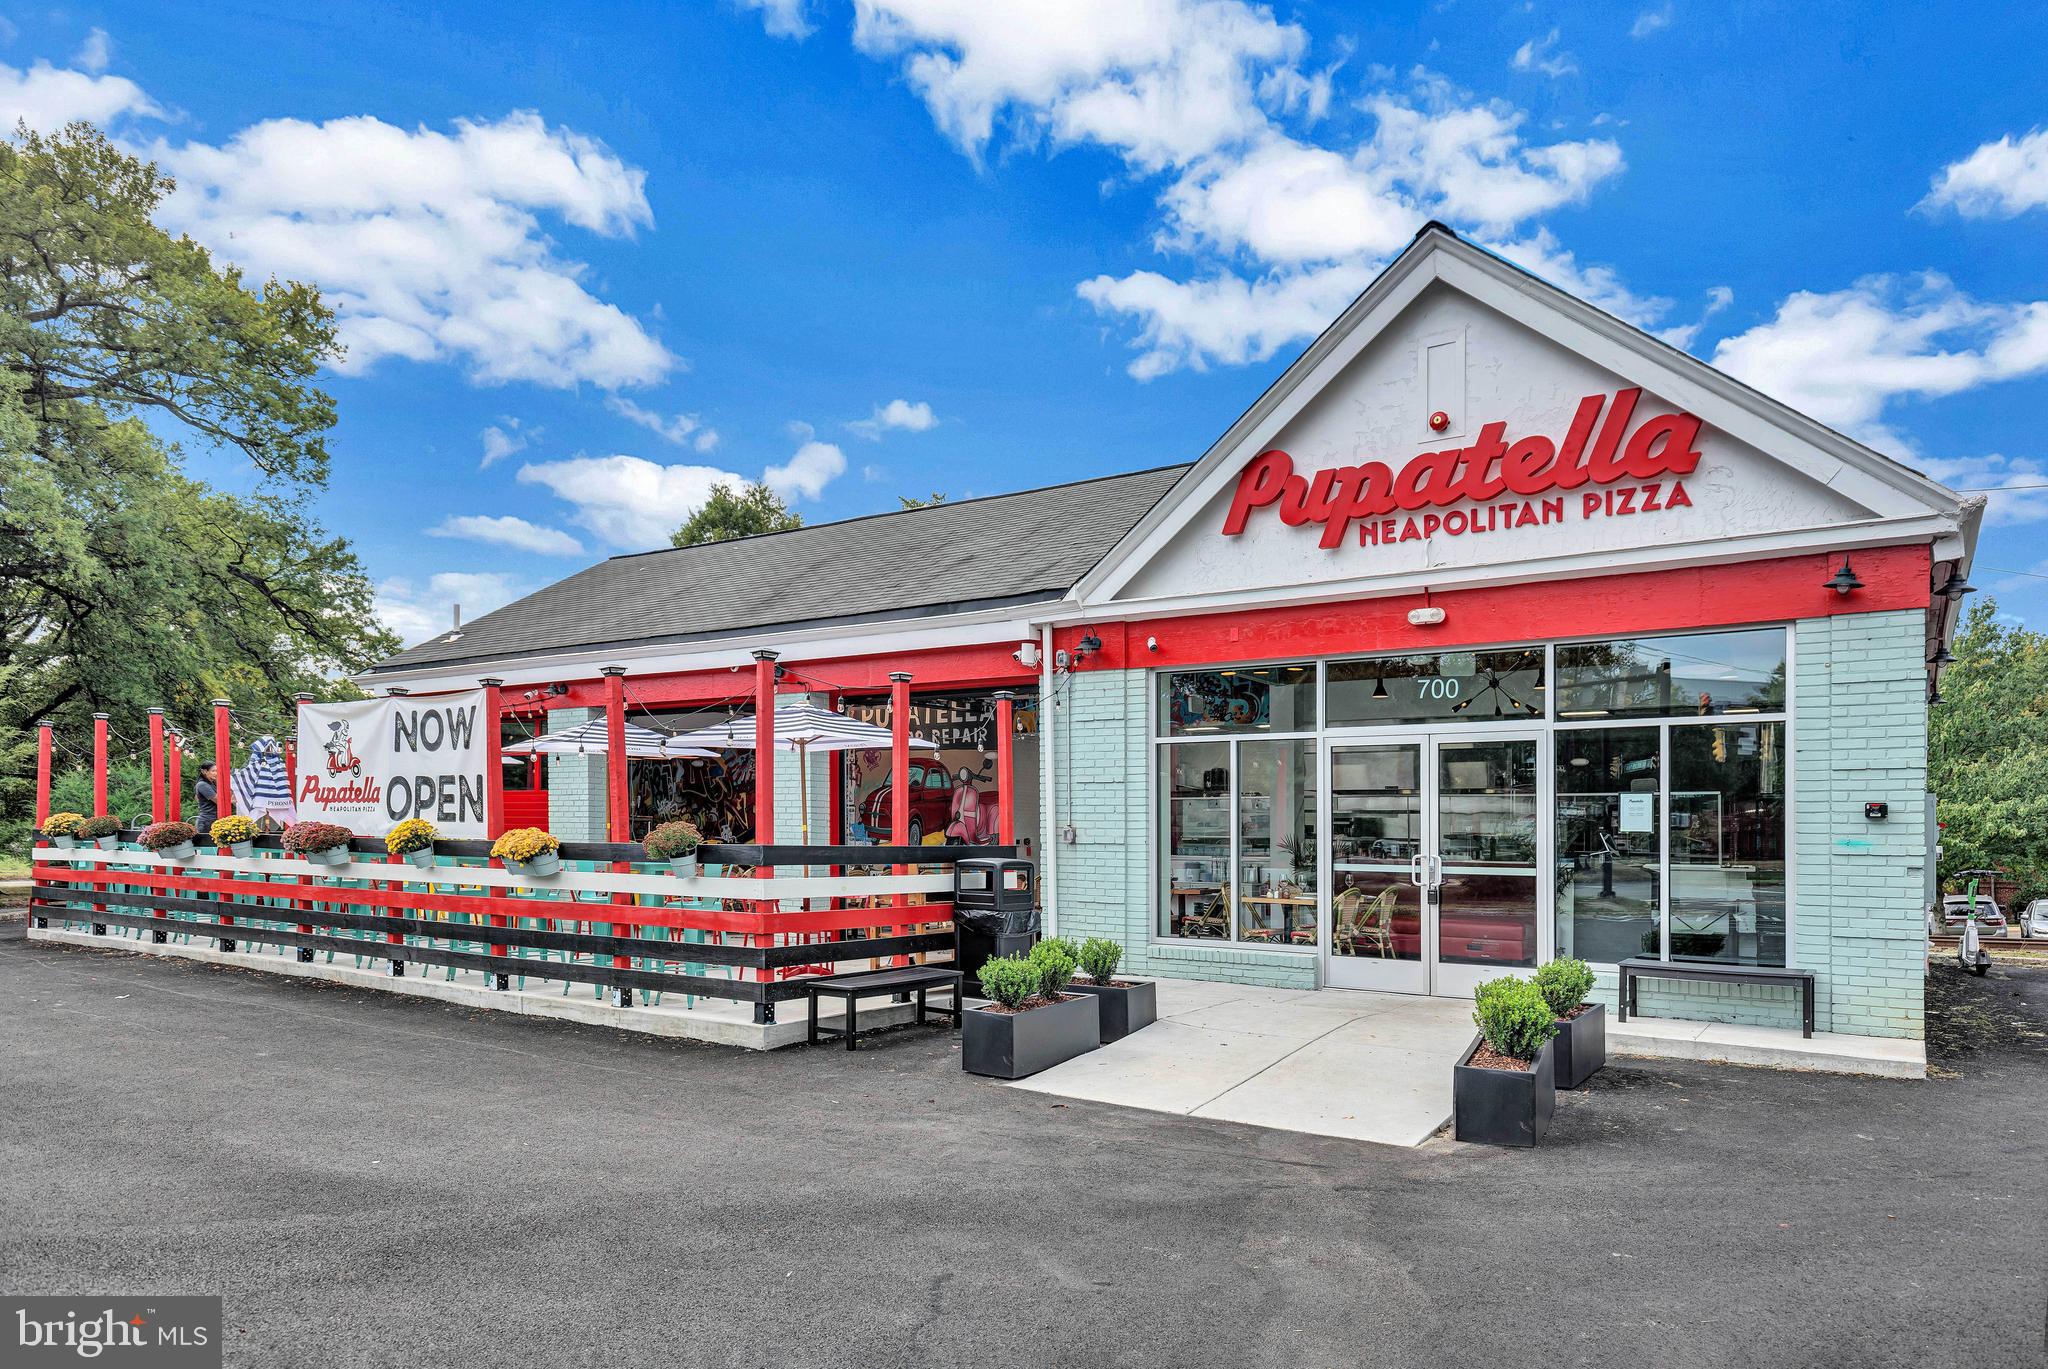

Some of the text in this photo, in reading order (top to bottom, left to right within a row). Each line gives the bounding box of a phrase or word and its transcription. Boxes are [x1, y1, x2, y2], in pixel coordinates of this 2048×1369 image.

[1221, 387, 1703, 549] Pupatella
[1359, 481, 1694, 547] NEAPOLITAN PIZZA
[1417, 678, 1459, 699] 700
[394, 705, 477, 753] NOW
[861, 698, 995, 728] PUATELLA
[931, 727, 988, 746] REPAIR
[299, 775, 381, 811] Pupatella
[386, 774, 484, 823] OPEN
